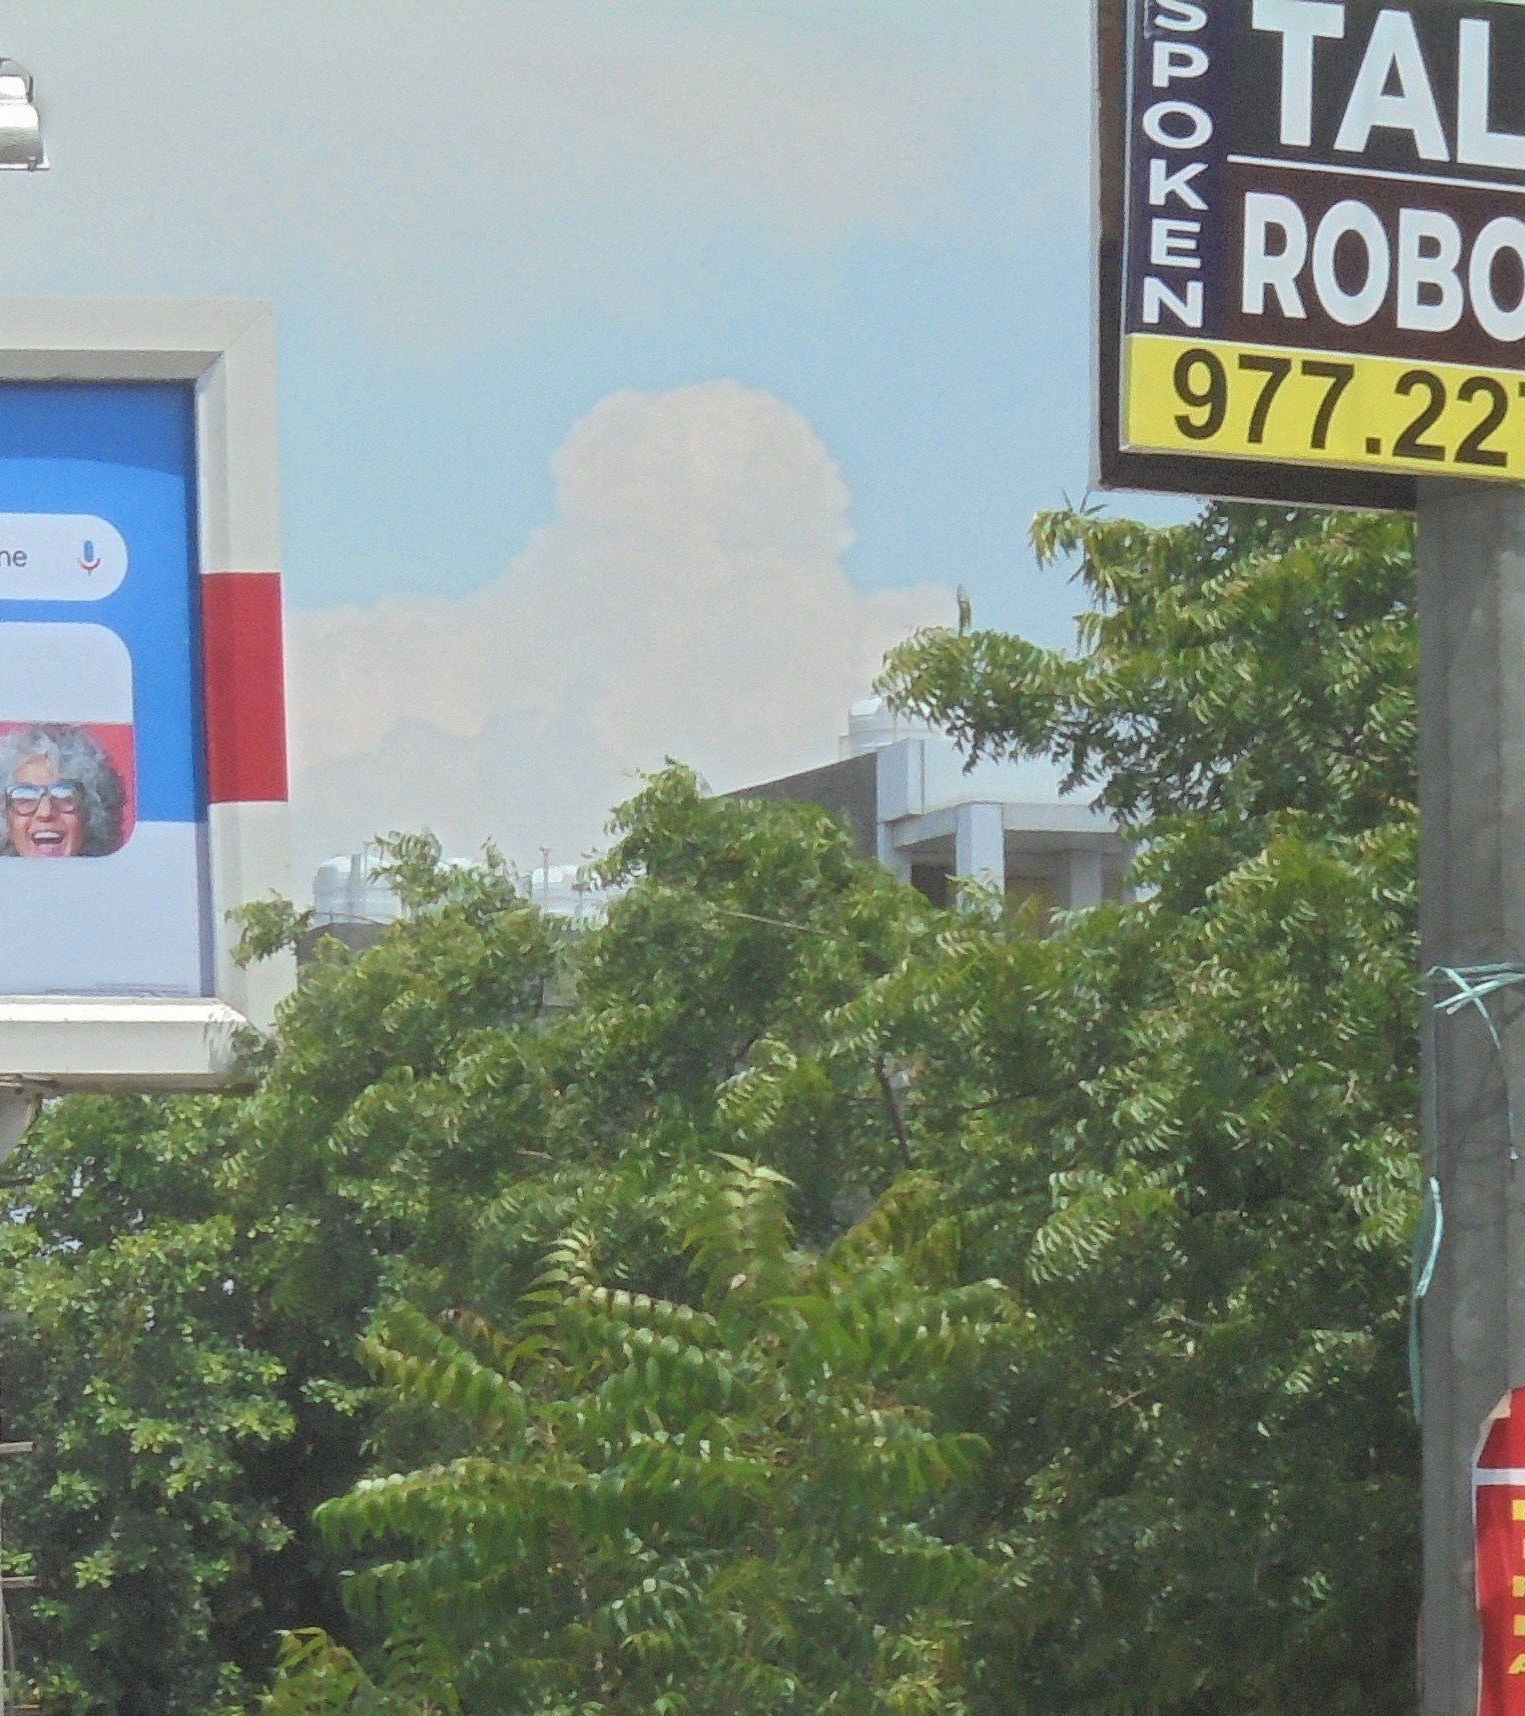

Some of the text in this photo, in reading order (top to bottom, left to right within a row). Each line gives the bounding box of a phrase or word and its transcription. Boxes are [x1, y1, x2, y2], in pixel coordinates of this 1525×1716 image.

[1142, 0, 1213, 328] SPOKEN
[1251, 0, 1525, 170] TAL
[1241, 191, 1525, 343] ROBO
[1172, 348, 1525, 469] 977.22
